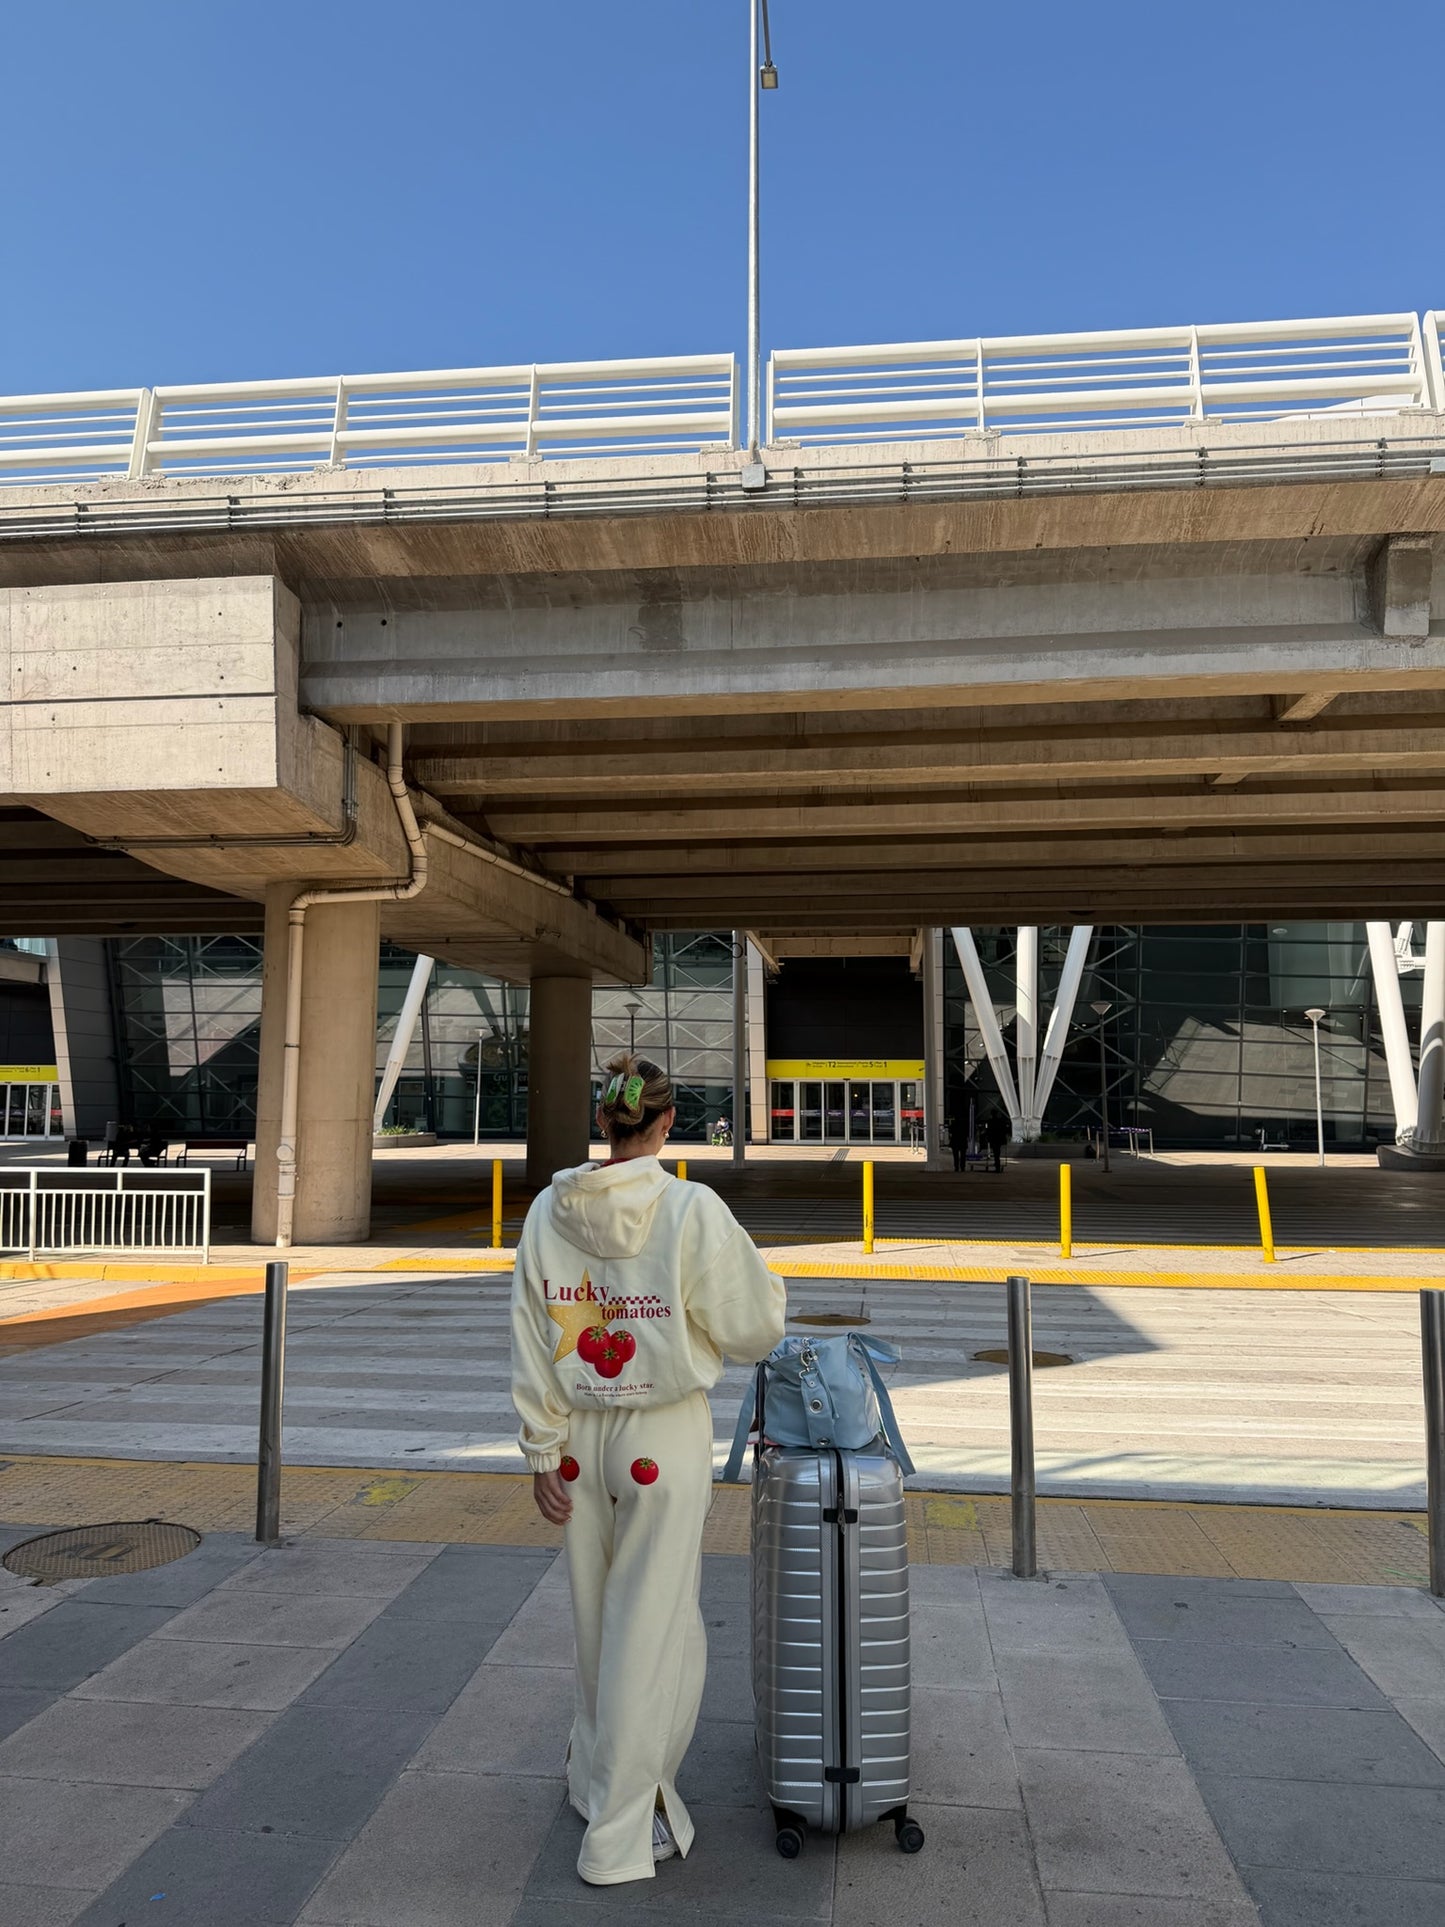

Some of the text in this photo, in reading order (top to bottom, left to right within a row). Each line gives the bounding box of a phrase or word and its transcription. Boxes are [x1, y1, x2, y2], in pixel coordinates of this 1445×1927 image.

[543, 1279, 610, 1307] Lucky
[601, 1304, 671, 1320] tomatoes
[576, 1383, 592, 1391] Born
[619, 1384, 637, 1392] lucky
